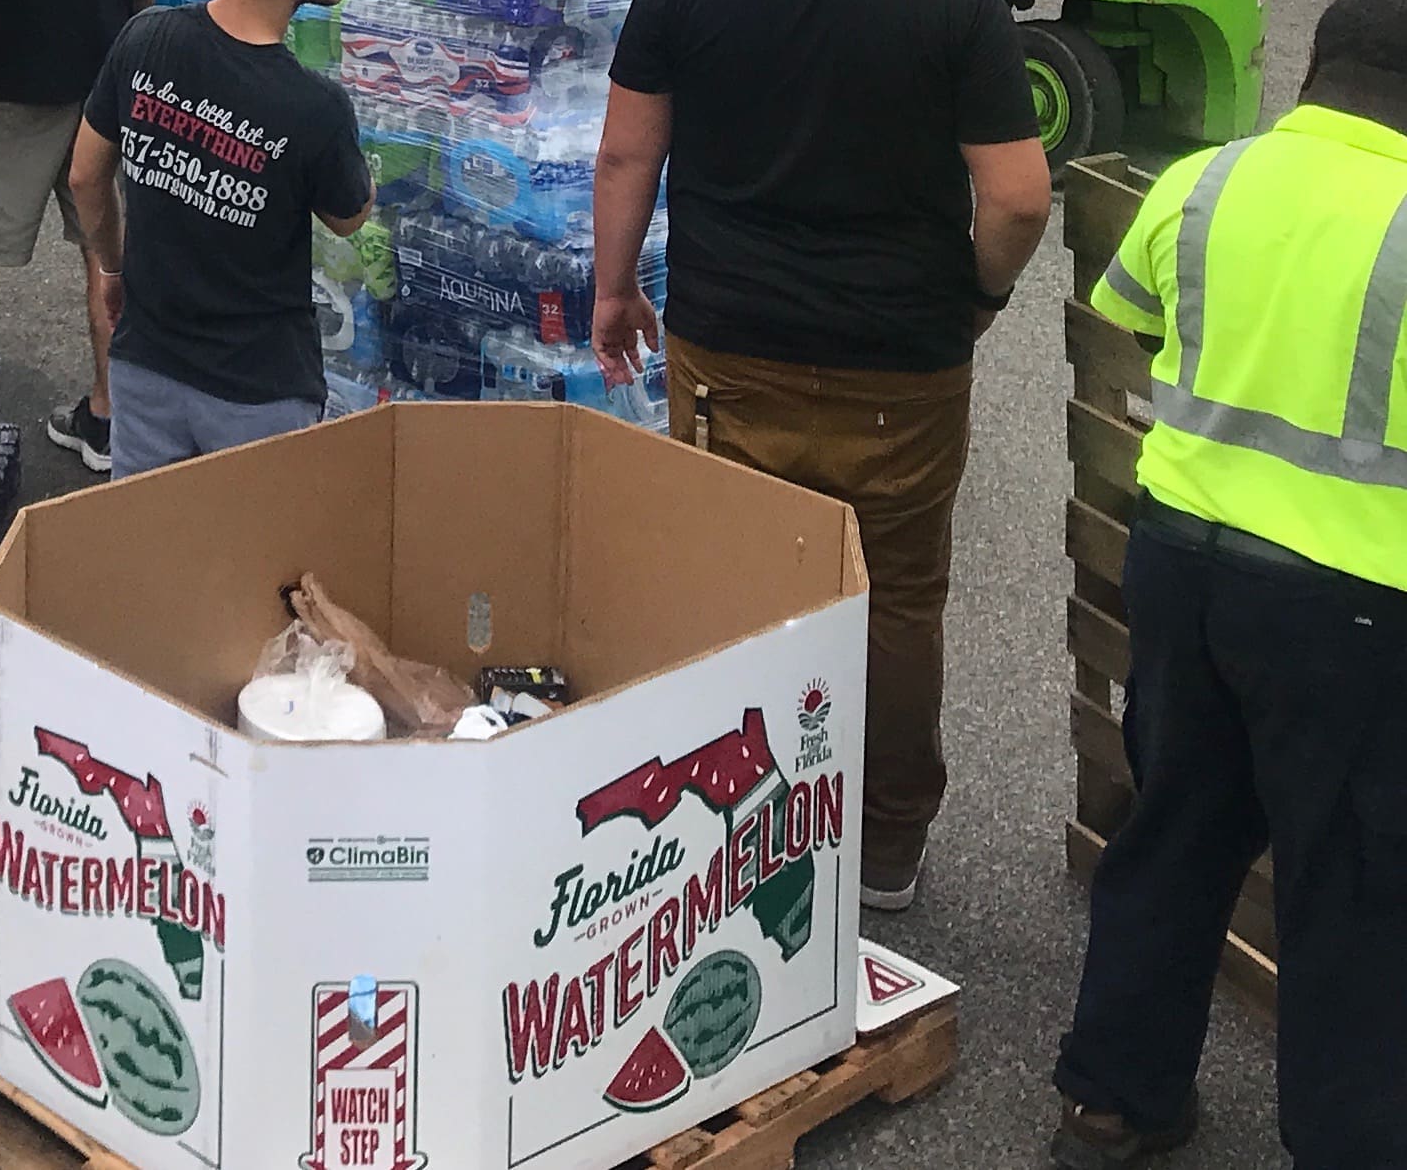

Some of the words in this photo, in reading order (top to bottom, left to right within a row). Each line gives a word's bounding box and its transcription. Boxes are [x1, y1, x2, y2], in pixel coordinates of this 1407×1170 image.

[131, 70, 155, 95] We
[156, 81, 180, 105] do
[180, 100, 194, 114] a
[195, 98, 234, 134] little
[235, 119, 264, 146] bit
[264, 137, 289, 160] of
[131, 93, 268, 174] EVERYTHING
[120, 125, 269, 211] 757-550-1888
[542, 304, 559, 315] 32
[795, 745, 832, 773] Florida
[801, 727, 828, 751] Fresh
[9, 766, 108, 842] Florida
[40, 820, 84, 847] GROWN
[329, 846, 430, 865] ClimaBin
[534, 834, 686, 948] Florida
[503, 770, 844, 1084] WATERMELON
[586, 895, 650, 941] GROWN
[331, 1088, 390, 1124] WATCH
[340, 1129, 380, 1166] STEP
